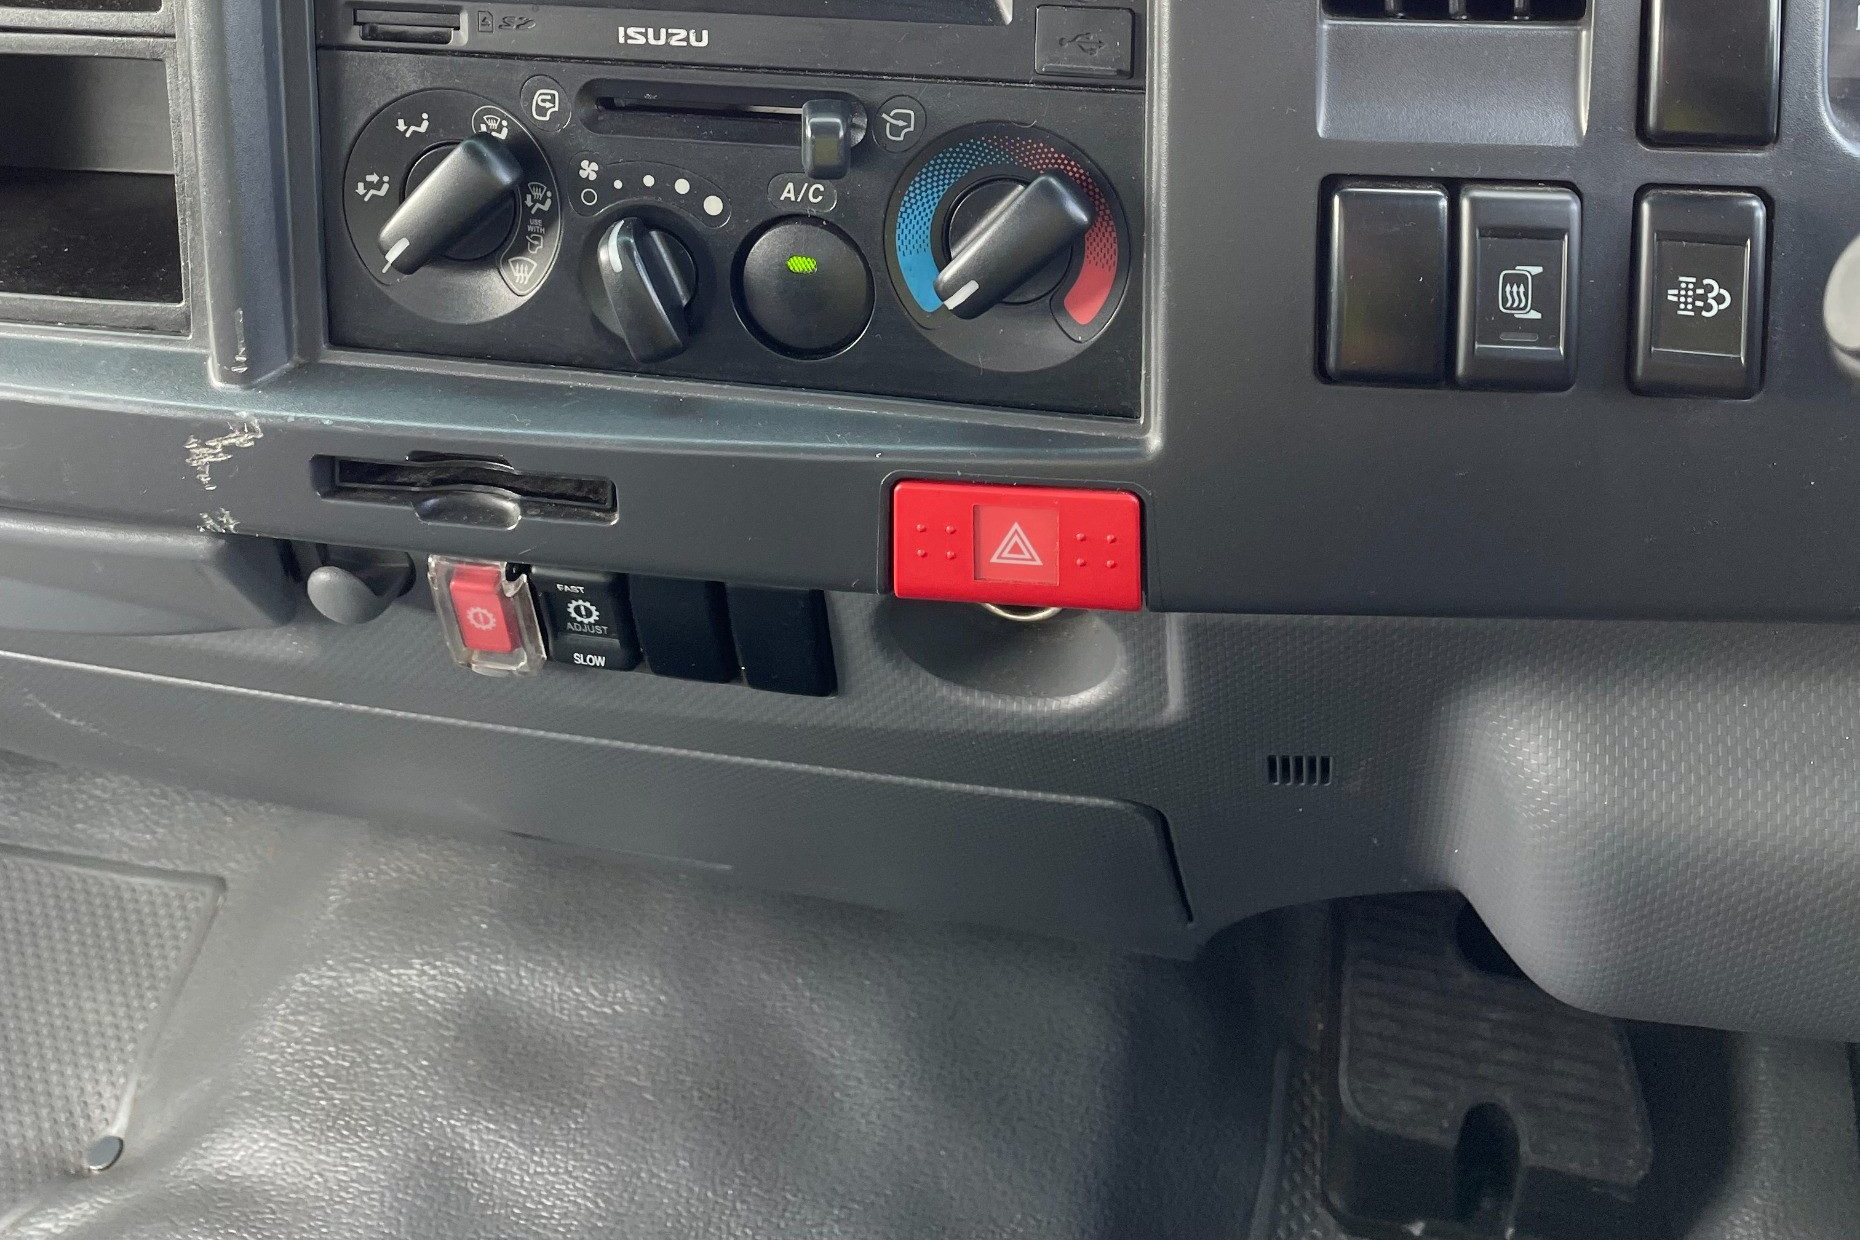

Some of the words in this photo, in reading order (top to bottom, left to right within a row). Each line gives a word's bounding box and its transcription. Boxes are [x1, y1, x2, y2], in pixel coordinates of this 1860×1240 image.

[617, 25, 710, 48] ISUZU
[779, 181, 825, 205] A/C
[527, 224, 546, 235] WITH
[529, 218, 543, 227] USE
[556, 583, 585, 594] FAST
[566, 621, 609, 635] ADJUST
[573, 652, 606, 667] SLOW
